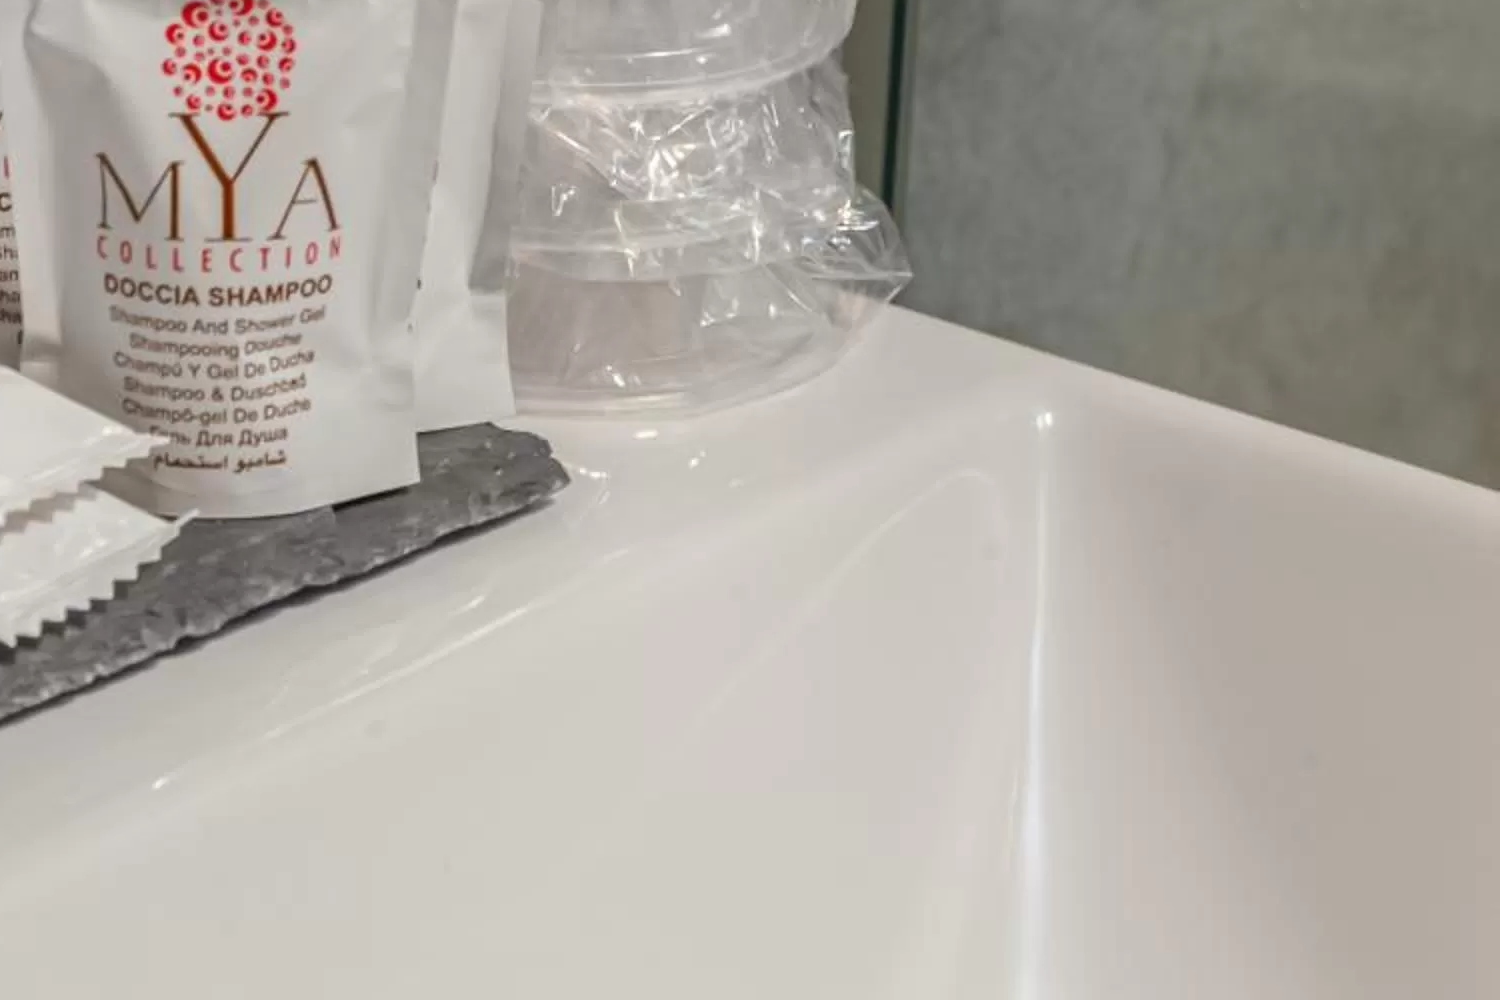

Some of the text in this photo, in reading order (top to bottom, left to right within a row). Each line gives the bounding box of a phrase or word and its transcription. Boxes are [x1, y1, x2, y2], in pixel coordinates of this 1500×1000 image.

[94, 112, 341, 242] MYA
[96, 235, 341, 273] COLLECTION
[104, 272, 332, 307] DOCCIA SHAMPOO
[109, 304, 326, 336] Shampoo And Shower Gel
[130, 332, 239, 360] Shampooing
[188, 363, 200, 378] Y
[207, 363, 239, 379] Gel
[245, 362, 265, 378] De
[124, 376, 204, 401] Shampoo
[211, 386, 223, 402] &
[234, 407, 257, 423] De
